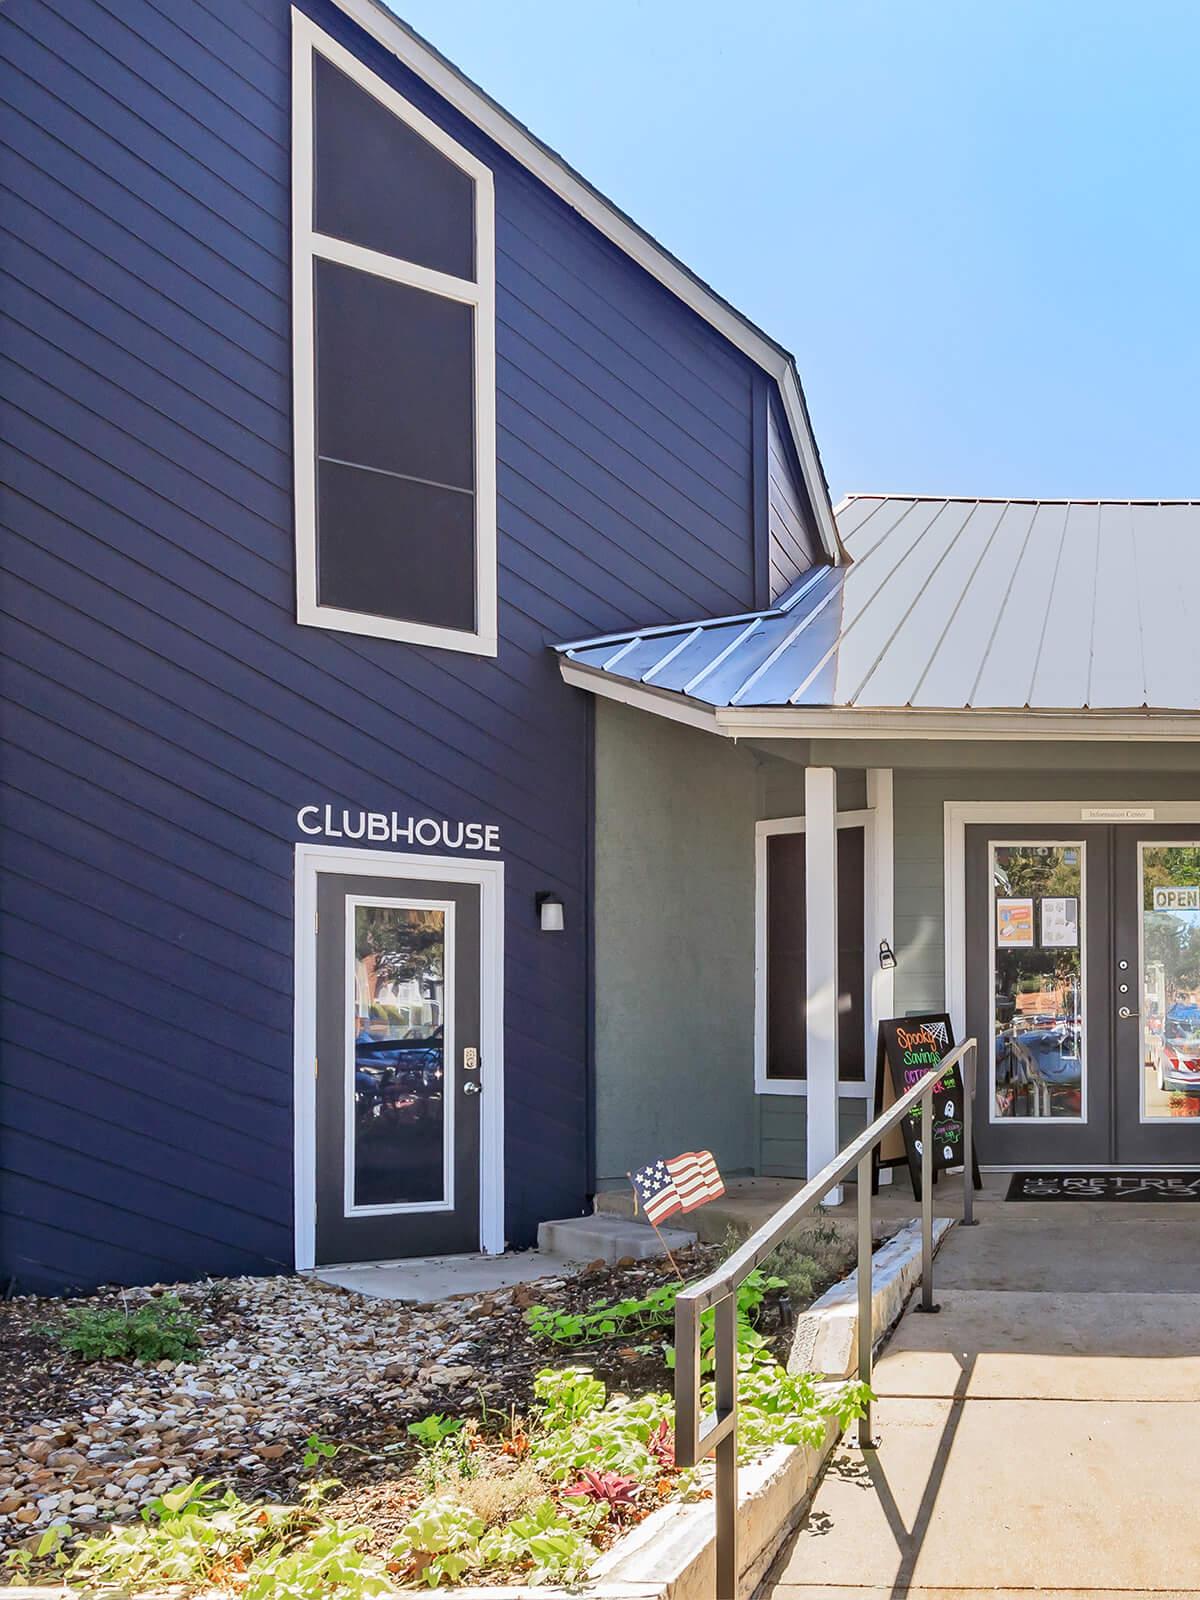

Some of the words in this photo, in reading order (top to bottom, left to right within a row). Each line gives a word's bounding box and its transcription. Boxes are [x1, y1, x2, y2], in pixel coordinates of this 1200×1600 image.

[296, 804, 501, 851] CLUBHOUSE
[1156, 891, 1198, 907] OPEN
[896, 1027, 937, 1052] Spooky
[904, 1050, 941, 1067] Savings
